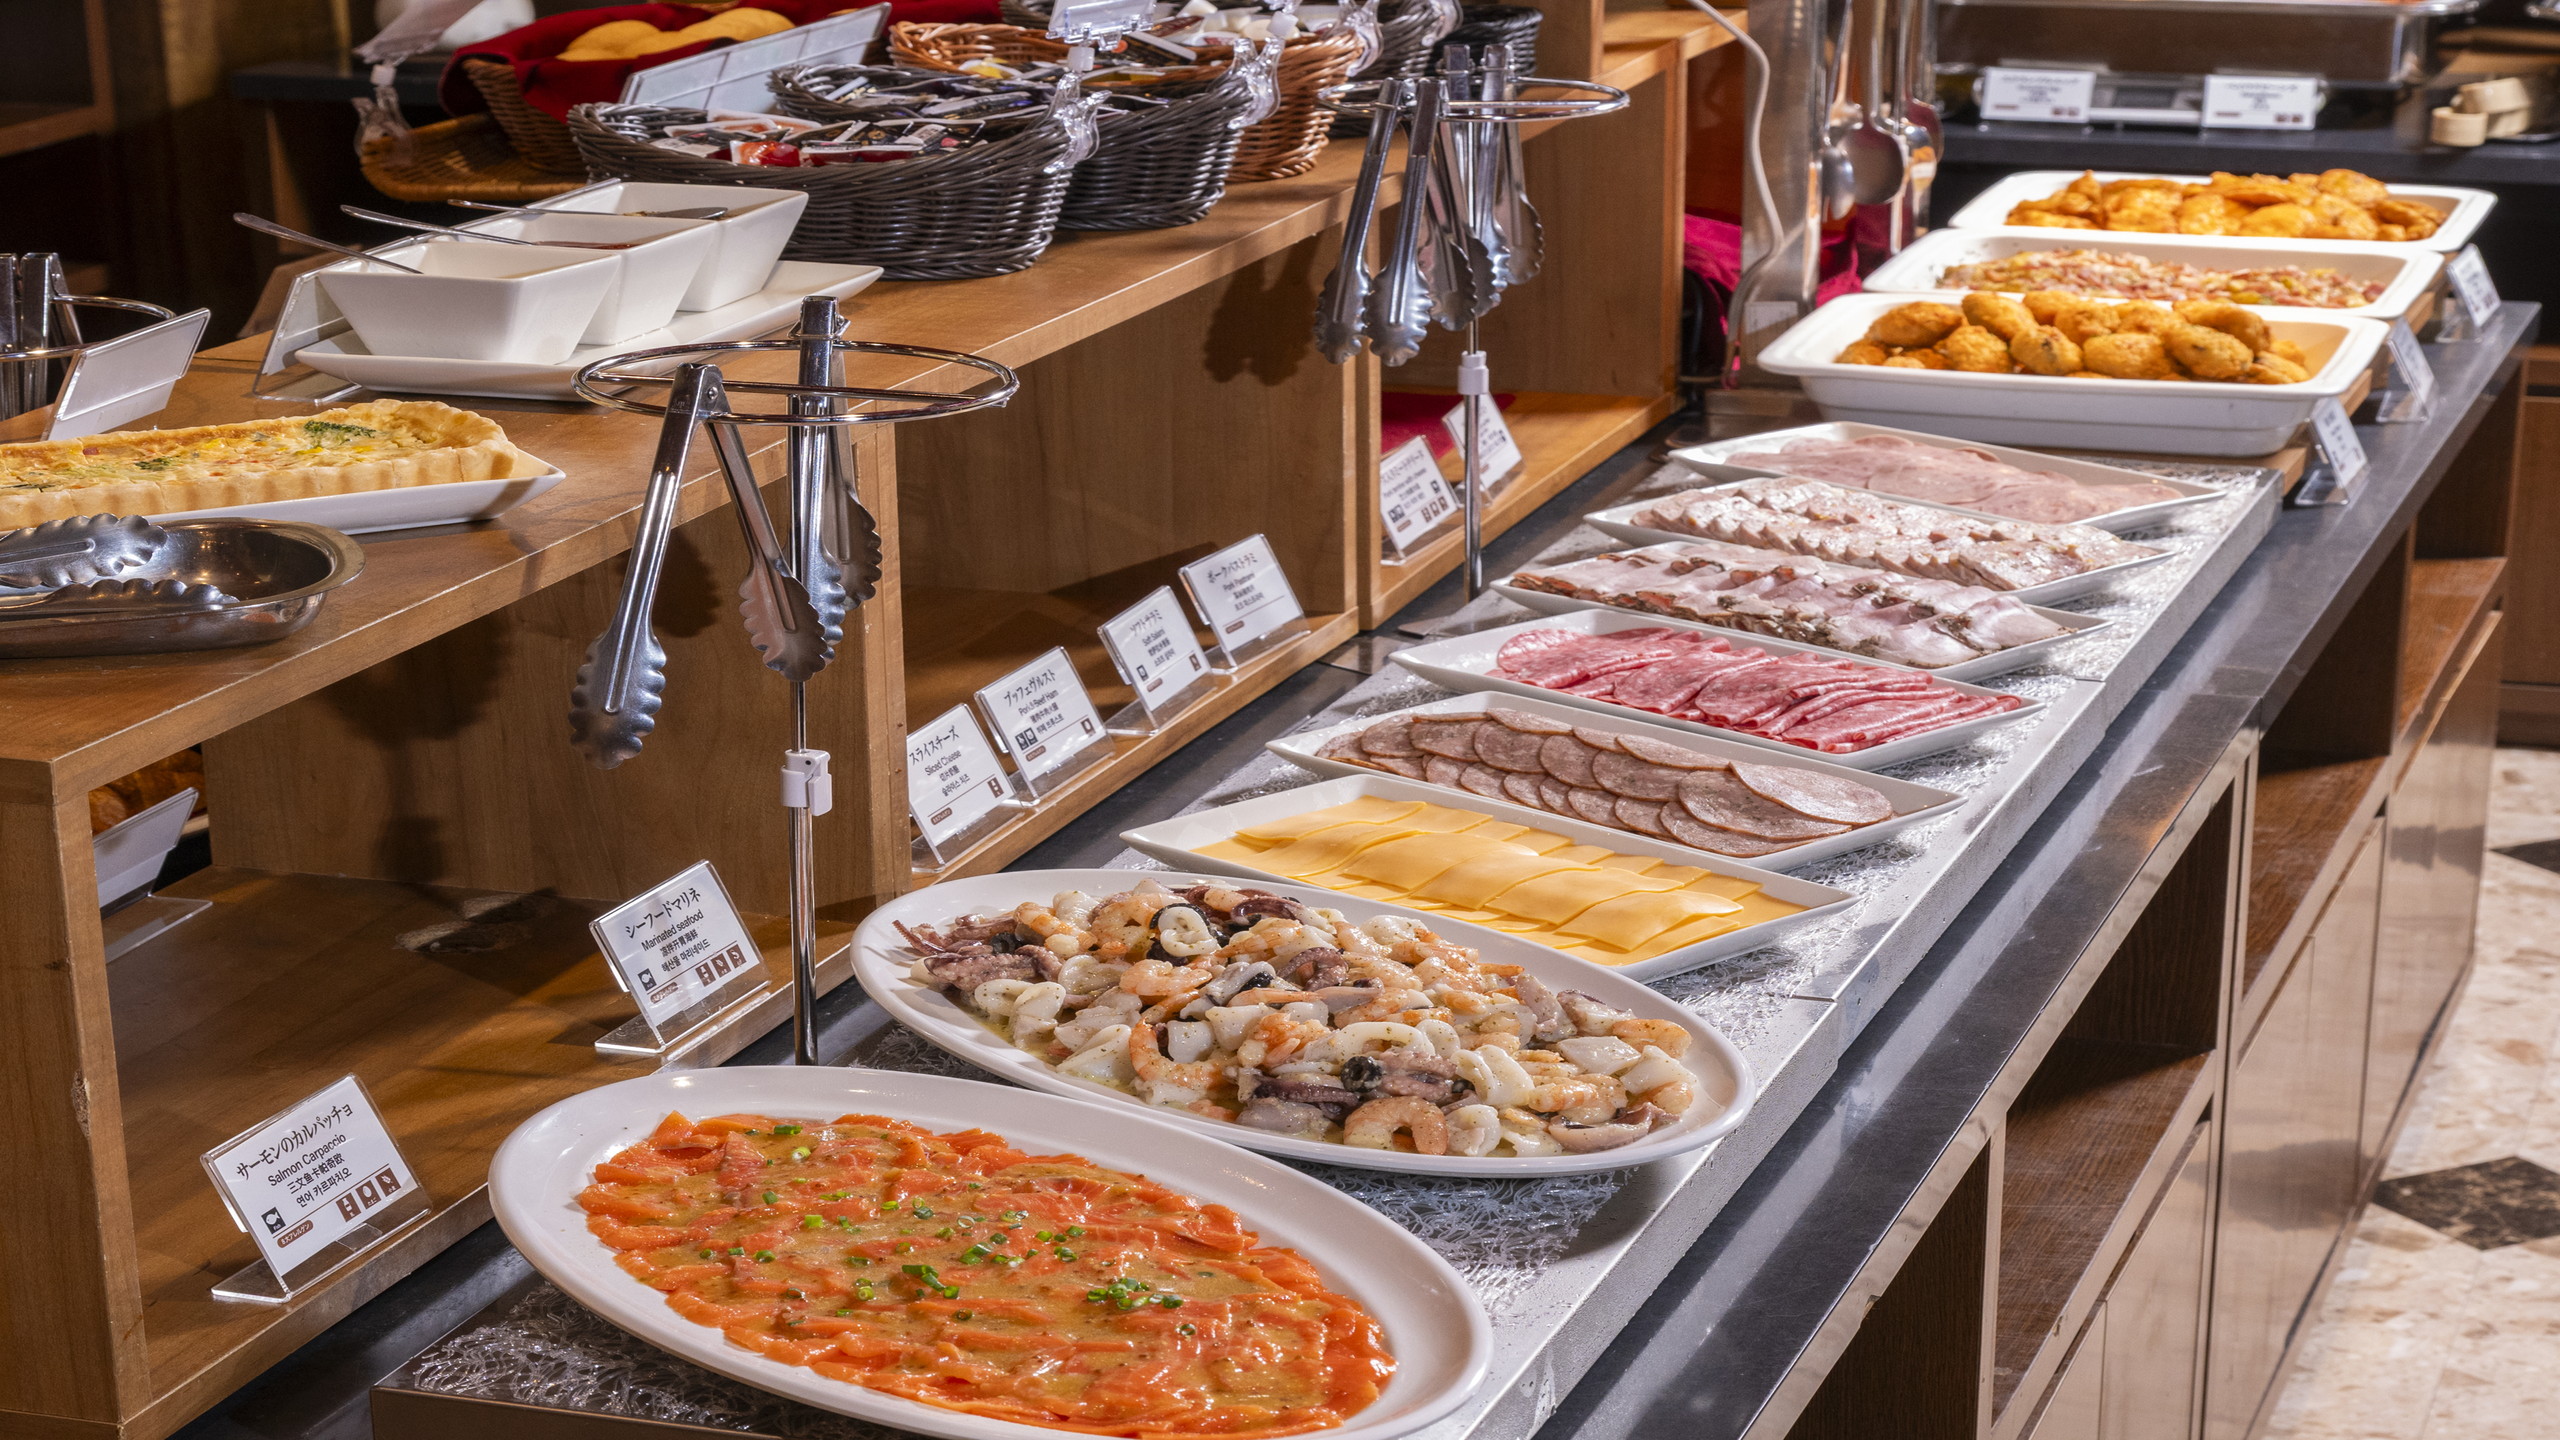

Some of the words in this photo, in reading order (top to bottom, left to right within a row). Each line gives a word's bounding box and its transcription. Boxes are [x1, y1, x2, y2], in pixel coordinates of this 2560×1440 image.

[908, 725, 959, 765] スライスチーズ
[924, 760, 943, 776] Sliced
[940, 750, 962, 766] Cheese
[625, 887, 701, 939] シーフードマリネ
[641, 924, 677, 951] Marinated
[676, 909, 704, 931] seafood
[661, 955, 681, 972] 해산물
[679, 938, 711, 961] 마리네이드
[237, 1104, 353, 1180] サーモンのカルパッチョ
[268, 1161, 303, 1186] Salmon
[302, 1134, 346, 1165] Carpaccio
[287, 1153, 345, 1194] 三文鱼卡帕奇欧
[296, 1190, 315, 1208] 연어
[312, 1167, 352, 1196] 카르파치오
